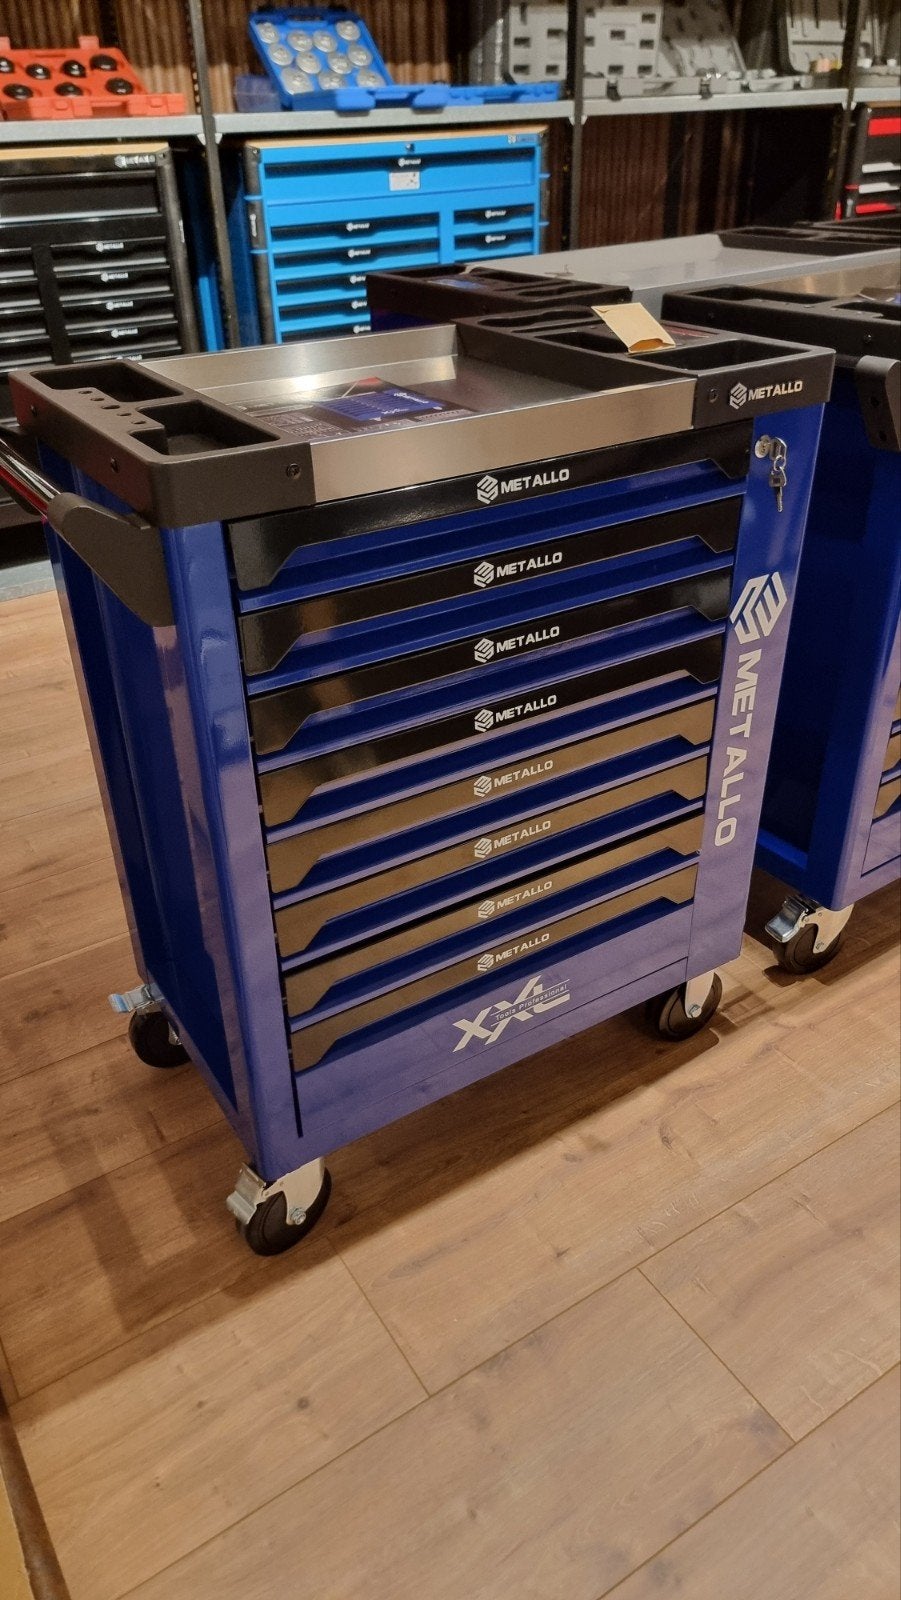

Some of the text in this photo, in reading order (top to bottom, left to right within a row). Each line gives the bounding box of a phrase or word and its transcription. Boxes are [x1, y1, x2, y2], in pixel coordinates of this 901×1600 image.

[748, 380, 803, 402] METALLO
[501, 468, 570, 494] METALLO
[497, 551, 563, 578] METALLO
[497, 625, 560, 654] METALLO
[495, 694, 557, 722] METALLO
[714, 649, 762, 847] METALLO
[494, 760, 553, 787] METALLO
[494, 820, 551, 849] METALLO
[497, 881, 553, 910] METALLO
[495, 933, 550, 962] METALLO
[495, 984, 567, 1021] Tools Professional
